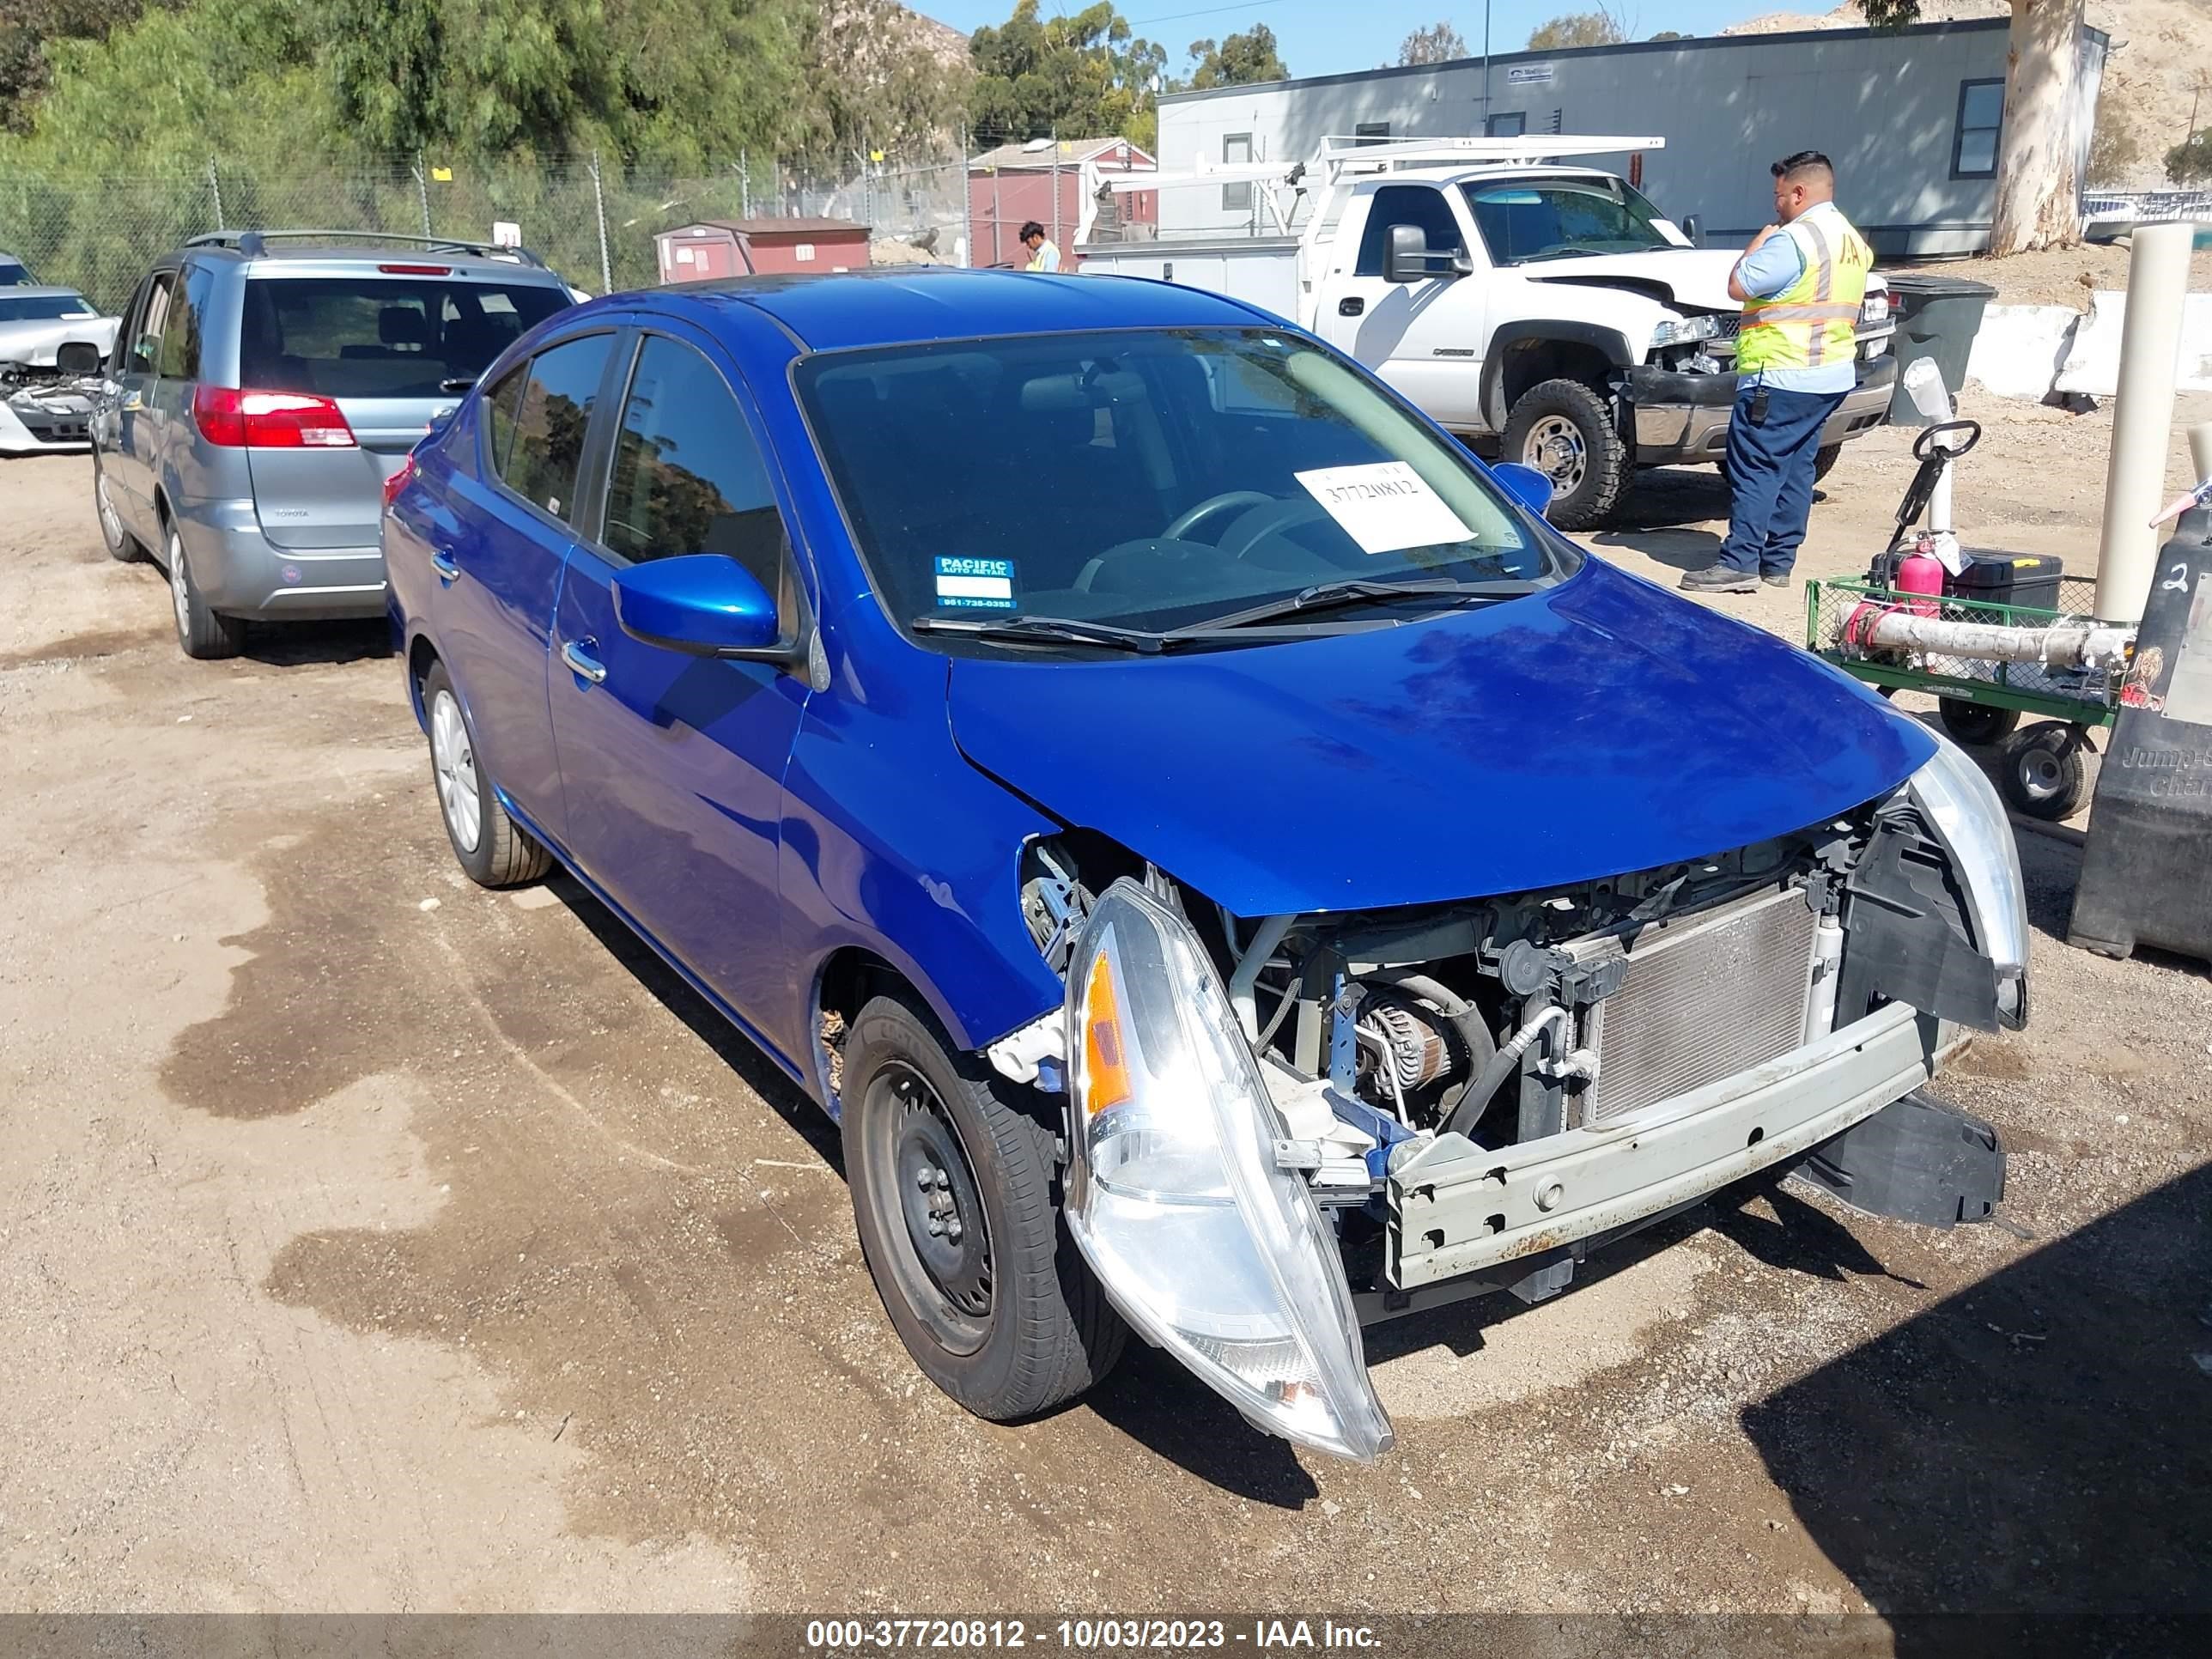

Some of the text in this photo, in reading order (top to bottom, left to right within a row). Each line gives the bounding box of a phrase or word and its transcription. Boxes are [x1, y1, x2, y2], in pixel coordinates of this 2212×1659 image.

[1325, 481, 1419, 503] 37720812
[941, 558, 1006, 570] PACIFIC
[2162, 562, 2189, 593] 2
